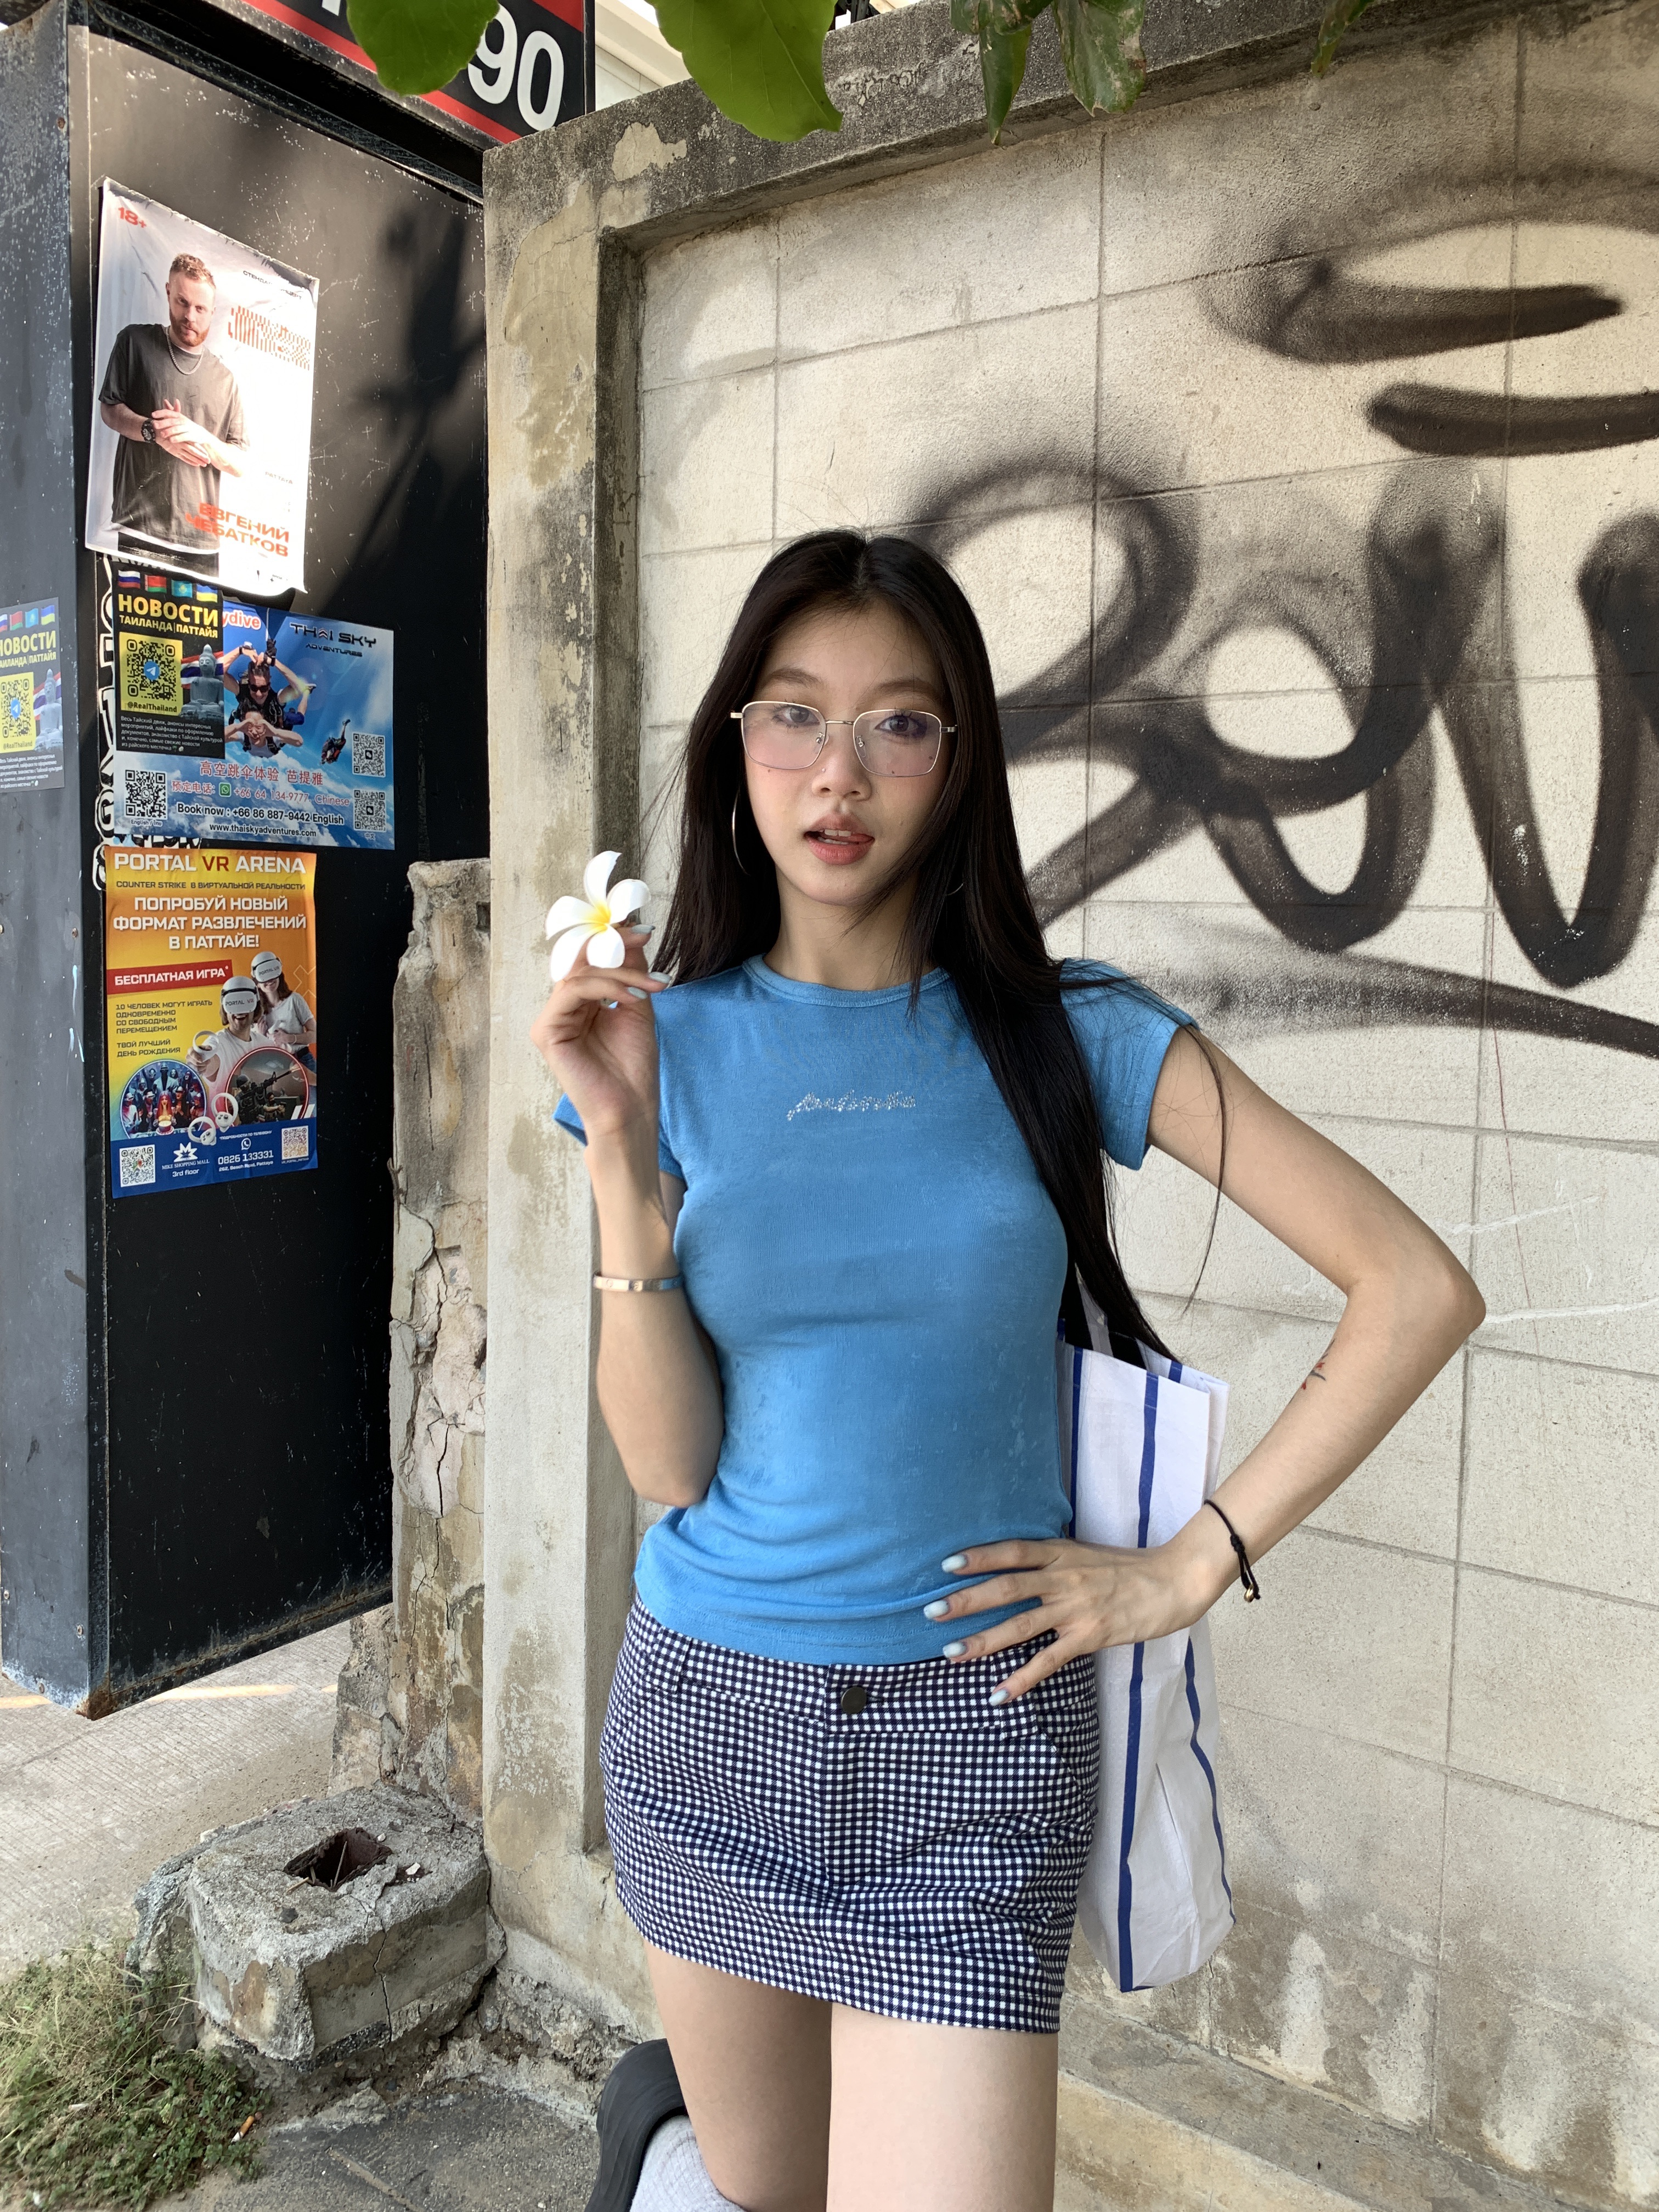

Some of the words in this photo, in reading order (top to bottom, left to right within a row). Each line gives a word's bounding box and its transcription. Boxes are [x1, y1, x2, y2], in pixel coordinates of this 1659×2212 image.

[118, 207, 147, 228] 18+
[243, 270, 273, 285] СТЕНДА
[199, 502, 290, 543] ЕВГЕНИЙ
[185, 512, 289, 557] ЧЕБАТКОВ
[118, 594, 218, 627] НОВОСТИ
[338, 632, 376, 648] SKY
[306, 643, 363, 657] ADVENTURES
[127, 702, 177, 713] @RealThailand
[200, 760, 279, 782] 高空跳伞体验
[286, 770, 323, 785] 芭提雅
[234, 788, 251, 798] +66
[255, 789, 266, 799] 64
[315, 794, 350, 806] Chinese
[177, 804, 201, 815] Book
[205, 808, 224, 816] now
[233, 809, 250, 817] +66
[253, 809, 264, 818] 86
[267, 810, 311, 822] 887-9442
[313, 813, 344, 825] English
[210, 824, 317, 837] www.thaiskyadventures.com
[114, 853, 198, 872] PORTAL
[202, 856, 229, 872] VR
[235, 855, 306, 874] ARENA
[198, 881, 254, 889] ВИРТУАЛЬНОЙ
[134, 895, 226, 911] ПОПРОБУЙ
[230, 895, 288, 911] НОВЫЙ
[113, 916, 188, 930] ФОРМАТ
[192, 913, 307, 930] РАЗВЛЕЧЕНИЙ
[169, 936, 180, 949] В
[185, 932, 259, 949] ПАТТАЙЕ!
[115, 970, 194, 986] БЕСПЛАТНАЯ
[116, 1010, 176, 1019] ОДНОВРЕМЕННО
[128, 1018, 176, 1026] СВОБОДНЫМ
[116, 1025, 177, 1034] ПЕРЕМЕЩЕНИЕМ
[138, 1039, 171, 1047] ЛУЧШИЙ
[139, 1047, 180, 1056] РОЖДЕНИЯ
[218, 1154, 240, 1165] 0826
[242, 1150, 274, 1162] 133331
